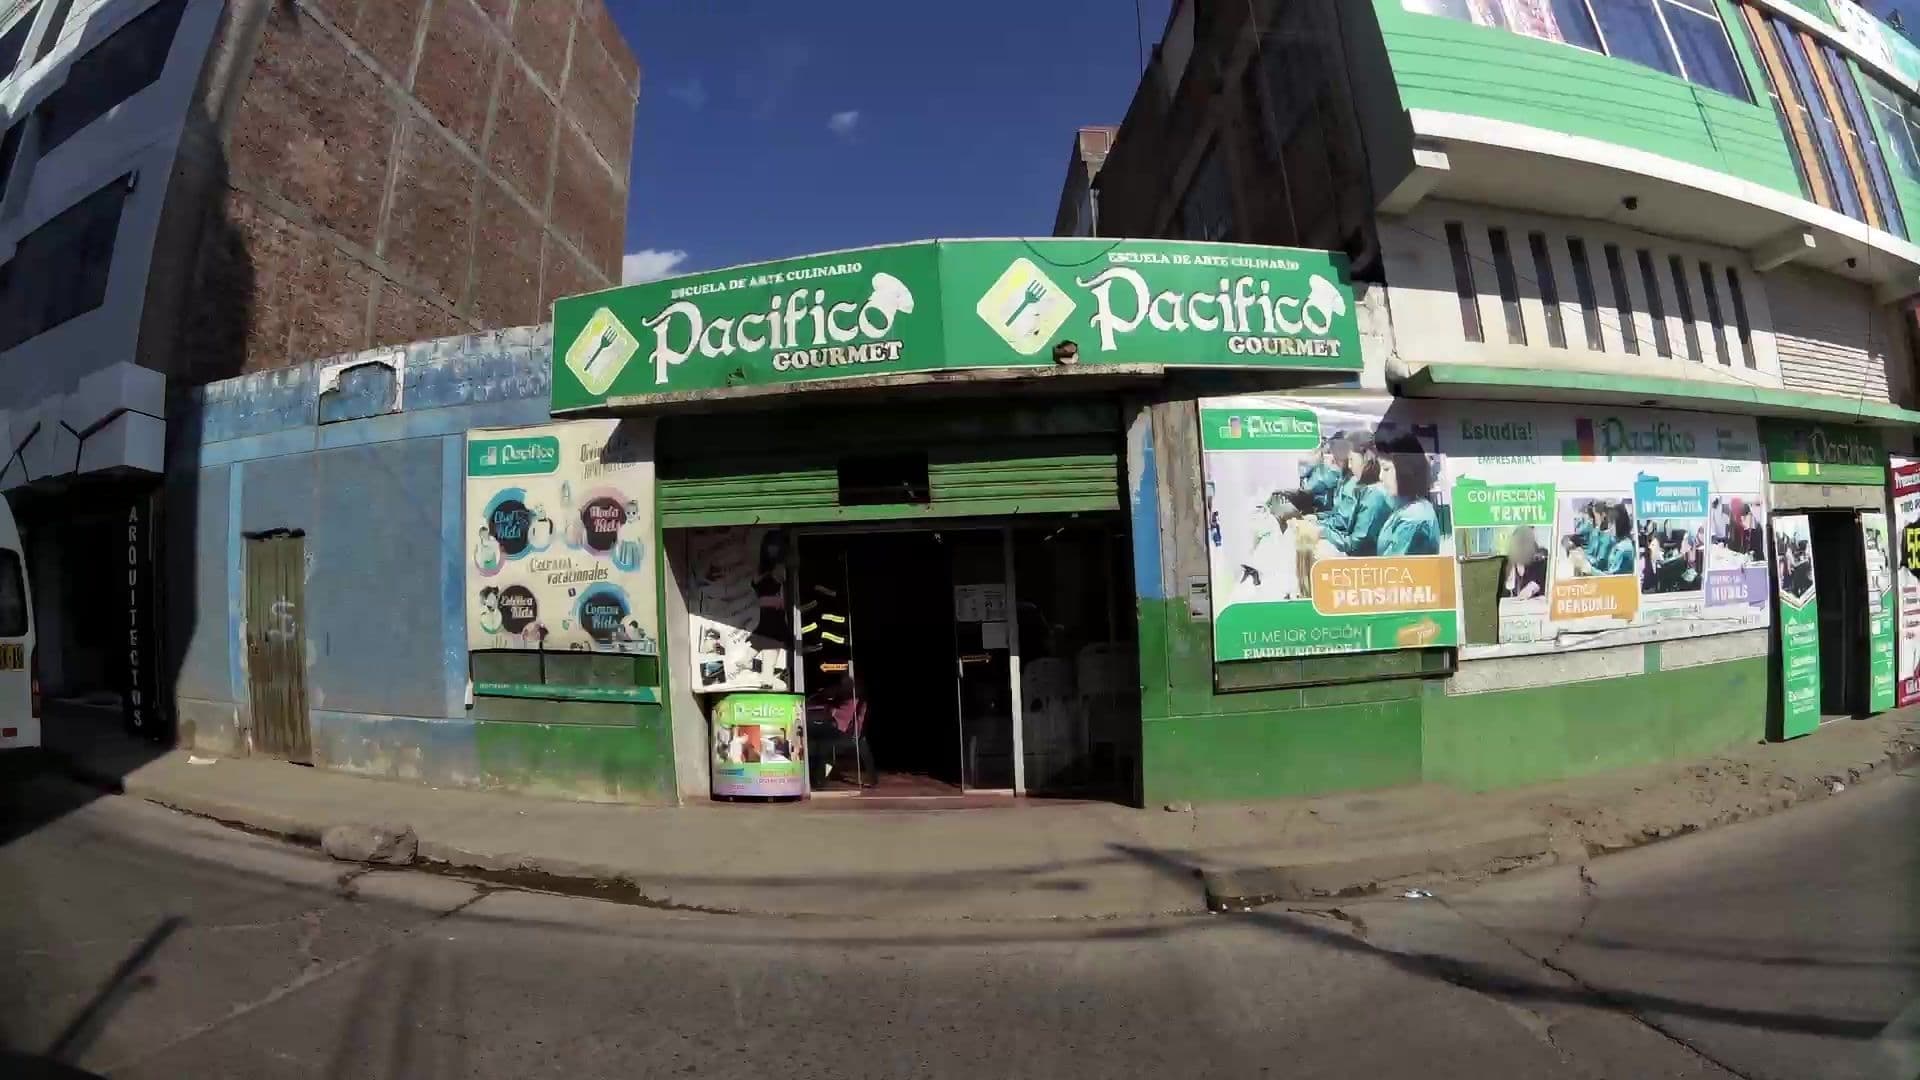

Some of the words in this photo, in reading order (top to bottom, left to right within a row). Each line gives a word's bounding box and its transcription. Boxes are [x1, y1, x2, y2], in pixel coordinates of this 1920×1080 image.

[1108, 252, 1170, 264] ESCUELA
[1173, 254, 1191, 265] DE
[1194, 255, 1228, 267] ARTE
[1231, 256, 1300, 271] CULINARIO
[671, 282, 729, 299] ESCUELA
[729, 278, 746, 290] DE
[750, 273, 785, 287] ARTE
[785, 262, 862, 281] CULINARIO
[1075, 266, 1334, 353] Pacifico
[641, 287, 896, 386] Pacifico
[1228, 335, 1341, 358] GOURMET
[772, 340, 904, 372] GOURMET
[1331, 563, 1416, 587] ESTÉTICA
[1242, 631, 1257, 645] TU
